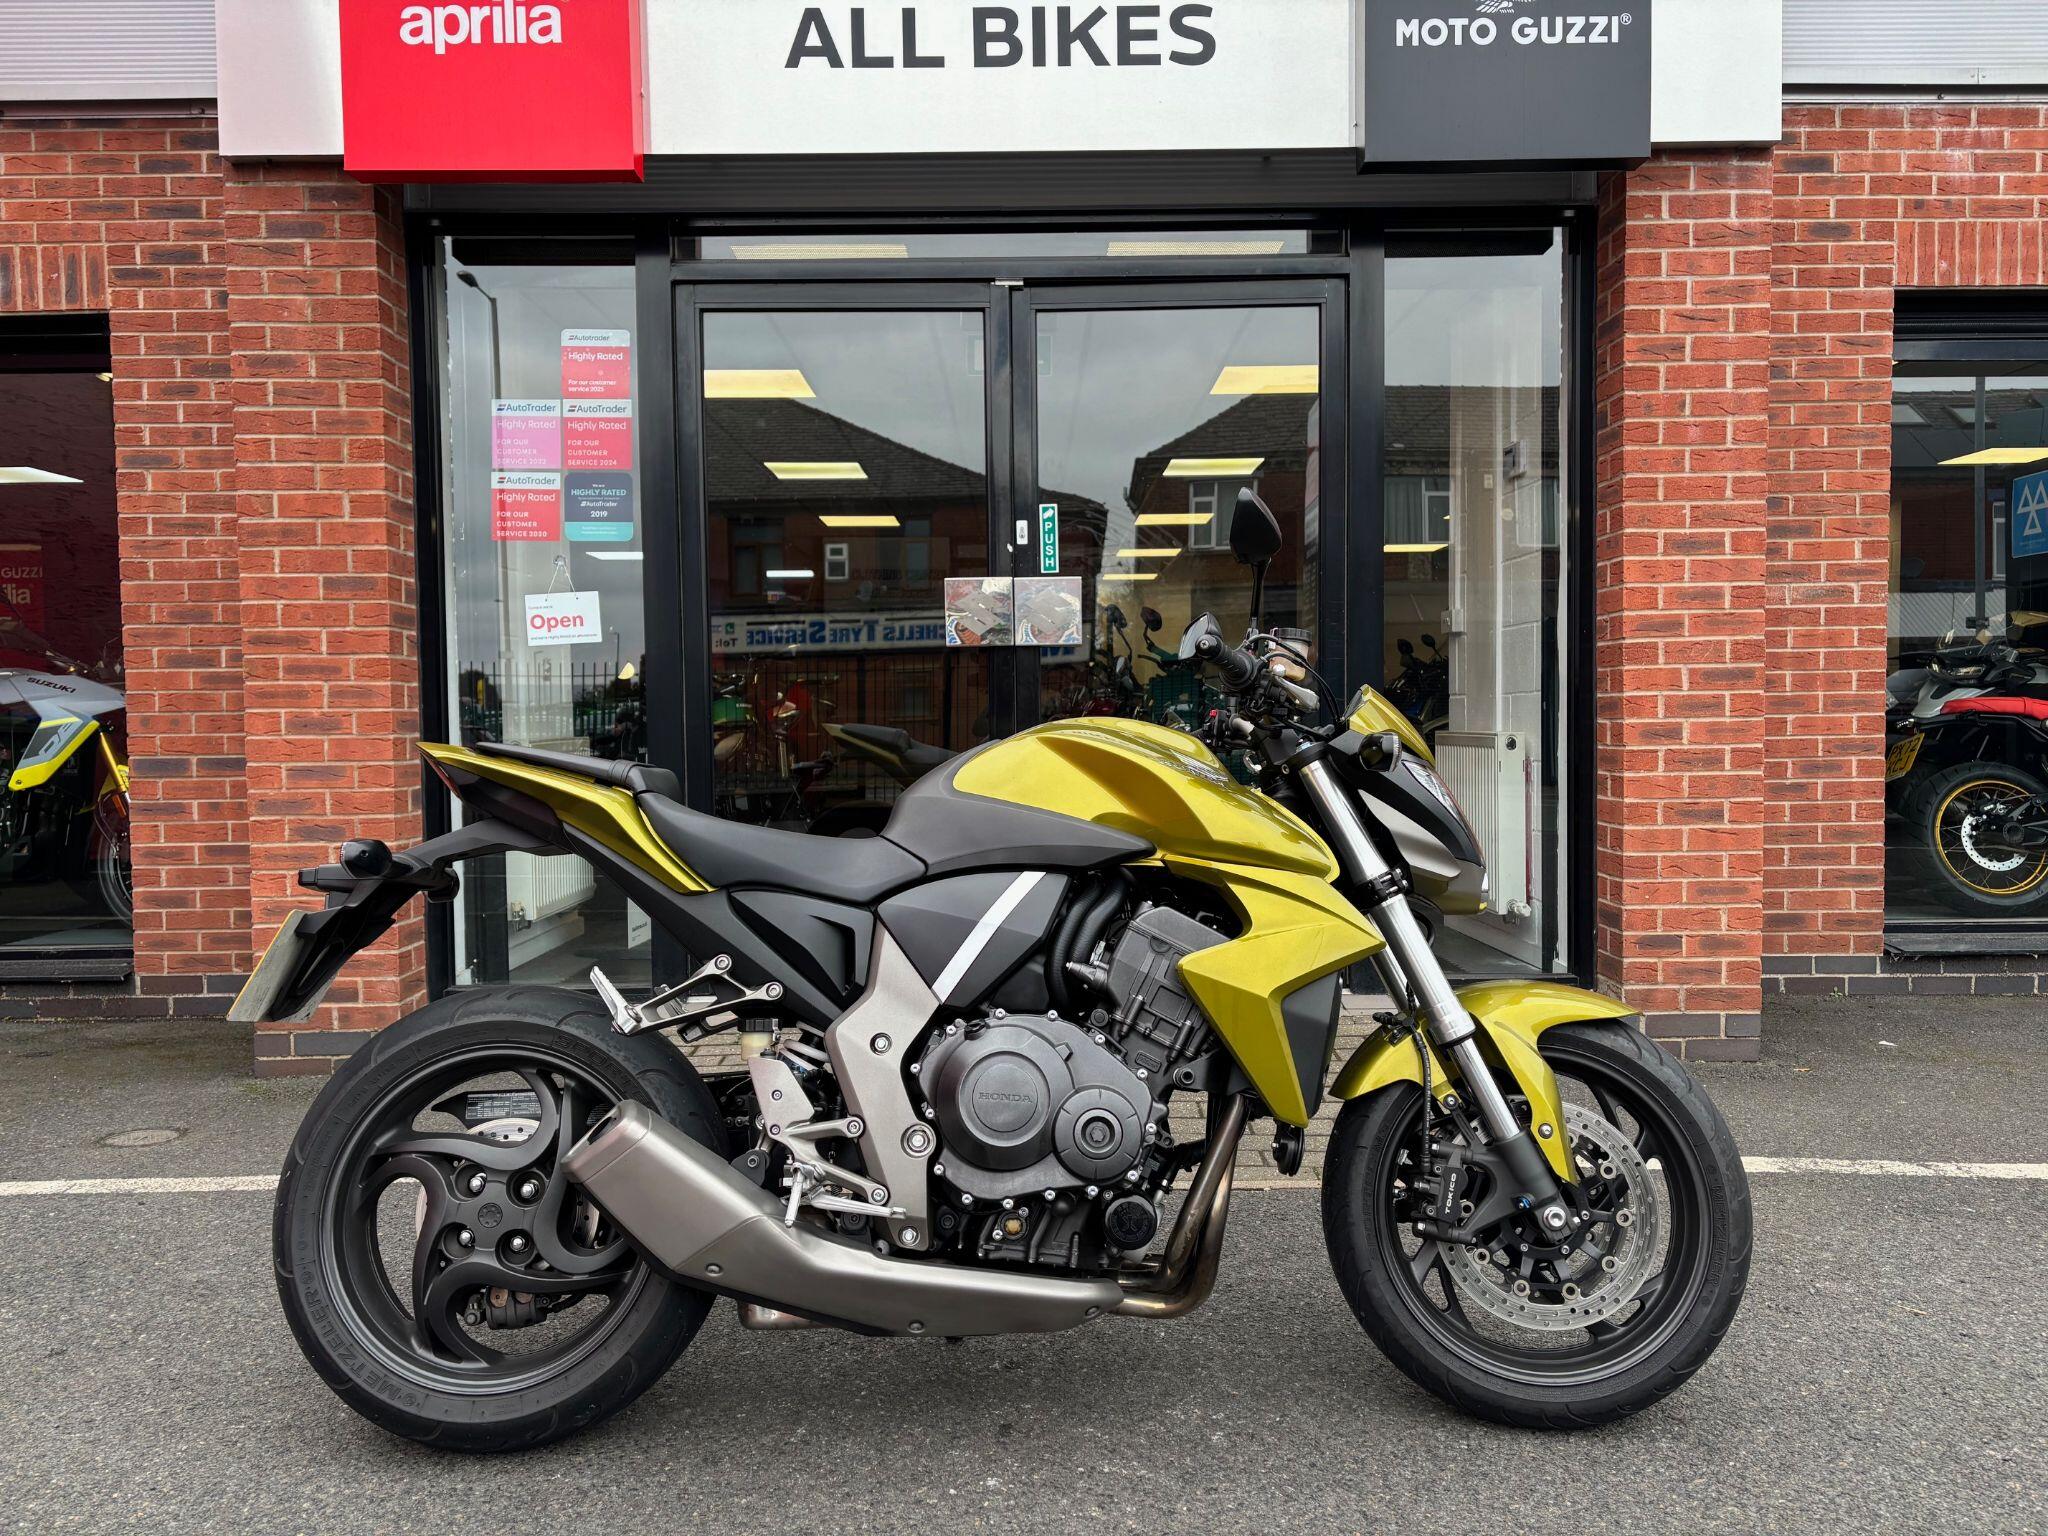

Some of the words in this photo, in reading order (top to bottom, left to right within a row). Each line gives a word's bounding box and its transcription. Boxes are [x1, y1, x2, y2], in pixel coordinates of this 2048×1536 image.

[400, 0, 562, 54] aprilia
[1396, 17, 1497, 47] MOTO
[784, 7, 945, 69] ALL
[972, 3, 1217, 68] BIKES
[568, 351, 596, 361] Highly
[597, 351, 623, 360] Rated
[507, 403, 556, 412] AutoTrader
[577, 404, 627, 413] AutoTrader
[498, 420, 527, 431] Highly
[528, 420, 556, 429] Rated
[567, 421, 598, 432] Highly
[598, 421, 627, 430] Rated
[506, 476, 557, 485] AutoTrader
[496, 492, 527, 503] Highly
[527, 492, 556, 501] Rated
[571, 488, 600, 496] HIGHLY
[601, 488, 627, 496] RATED
[590, 510, 608, 518] 2019
[1044, 521, 1055, 568] PUSH
[1, 567, 43, 579] GUZZI
[530, 614, 584, 633] Open
[26, 677, 77, 694] SUZUKI
[978, 1092, 1033, 1104] HONDA
[1444, 1172, 1457, 1215] TOKICO
